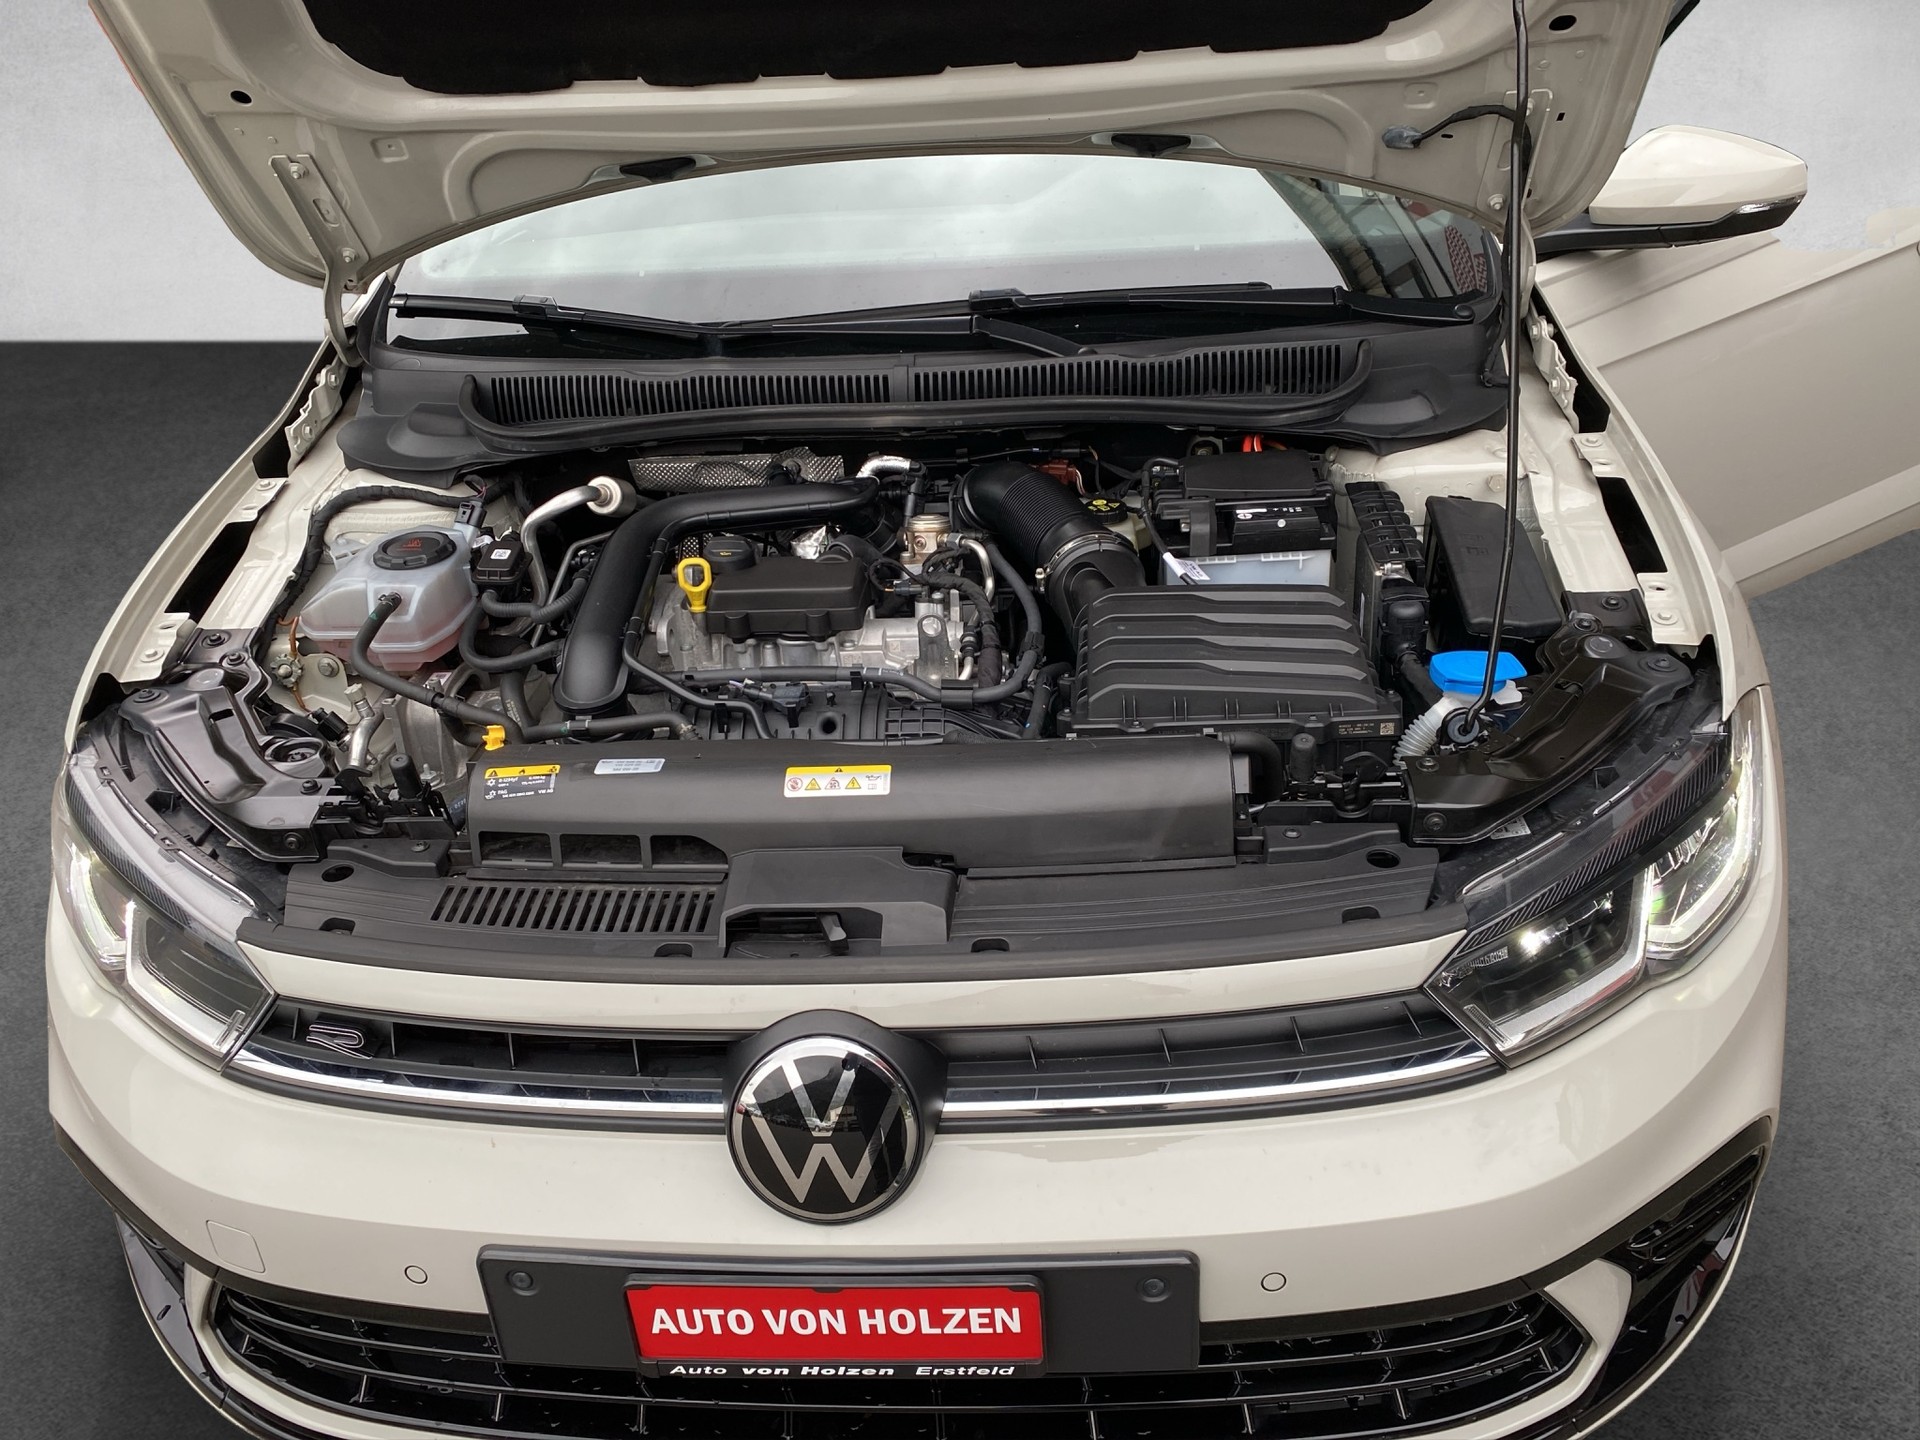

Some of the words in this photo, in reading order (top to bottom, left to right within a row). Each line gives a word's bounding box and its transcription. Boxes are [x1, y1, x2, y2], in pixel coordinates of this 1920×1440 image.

[742, 1045, 908, 1206] VW
[651, 1308, 755, 1336] AUTO
[761, 1308, 847, 1336] VON
[858, 1307, 1021, 1335] HOLZEN
[669, 1365, 727, 1375] Auto
[742, 1367, 790, 1375] von
[800, 1366, 895, 1376] Holzen
[915, 1366, 1015, 1376] Erstfeld
